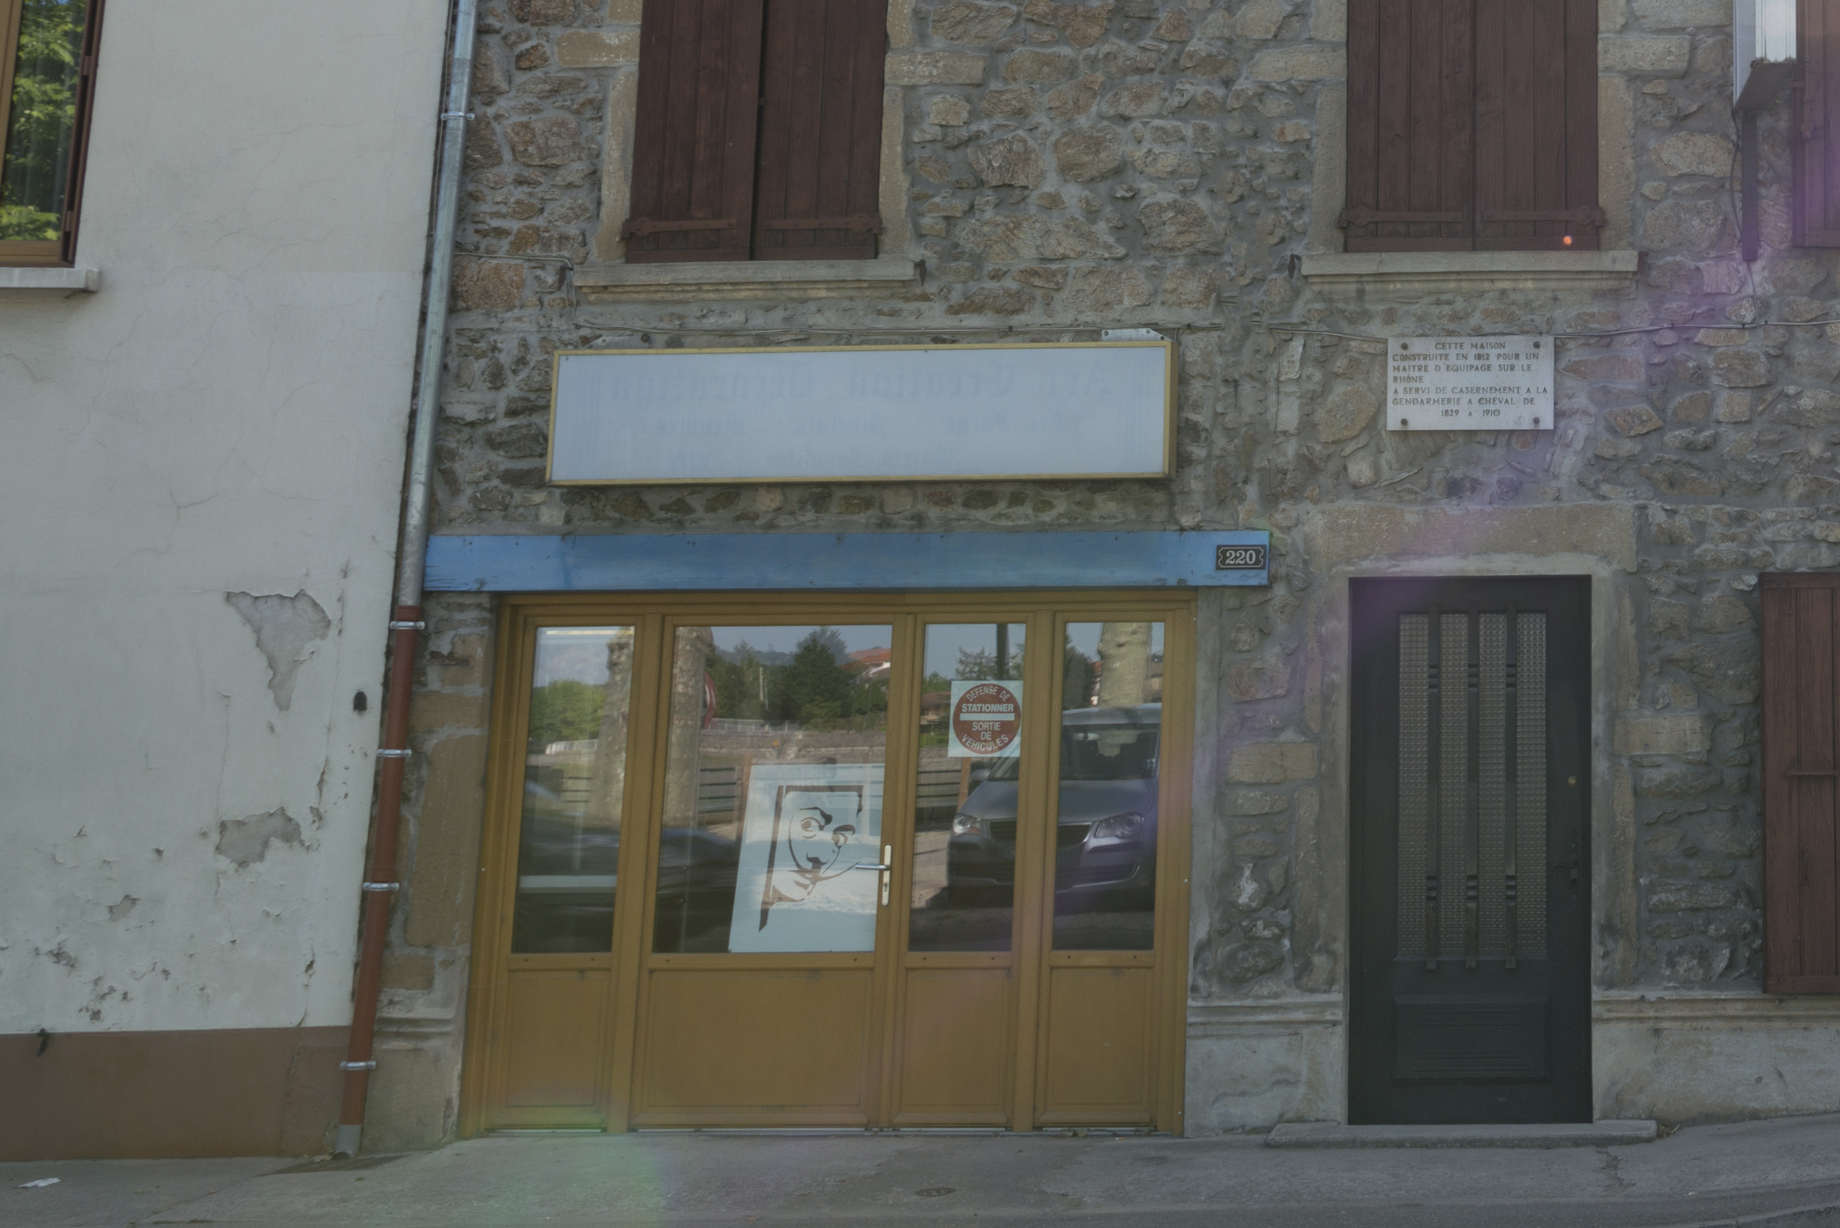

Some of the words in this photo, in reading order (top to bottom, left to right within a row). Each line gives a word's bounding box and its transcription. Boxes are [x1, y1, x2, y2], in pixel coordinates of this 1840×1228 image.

[1434, 342, 1465, 350] CETTE
[1470, 342, 1506, 350] MAISON
[1392, 353, 1450, 362] CONSTRUITE
[1456, 353, 1468, 361] EN
[1474, 352, 1490, 361] 1812
[1496, 352, 1520, 361] POUR
[1525, 352, 1539, 360] UN
[1392, 364, 1429, 373] MAITRE
[1498, 364, 1516, 372] SUR
[1521, 364, 1532, 372] LE
[1393, 373, 1424, 383] RHÔNE
[1393, 387, 1399, 395] A
[1403, 387, 1430, 395] SERVI
[1451, 386, 1521, 394] CASERNEMENT
[1525, 386, 1532, 394] A
[1536, 386, 1548, 394] LA
[1392, 397, 1462, 405] GENDARMERIE
[1467, 397, 1473, 405] A
[1478, 397, 1516, 405] CHEVAL
[1523, 397, 1536, 405] DE
[1441, 409, 1460, 417] 1829
[1482, 409, 1501, 417] 1910
[1225, 550, 1256, 564] 220
[966, 685, 999, 702] DEFENSE
[999, 690, 1011, 701] DE
[961, 703, 1014, 712] STATIONNER
[972, 722, 1001, 731] SORTIE
[980, 731, 992, 740] DE
[961, 734, 1009, 751] VEHICULES
